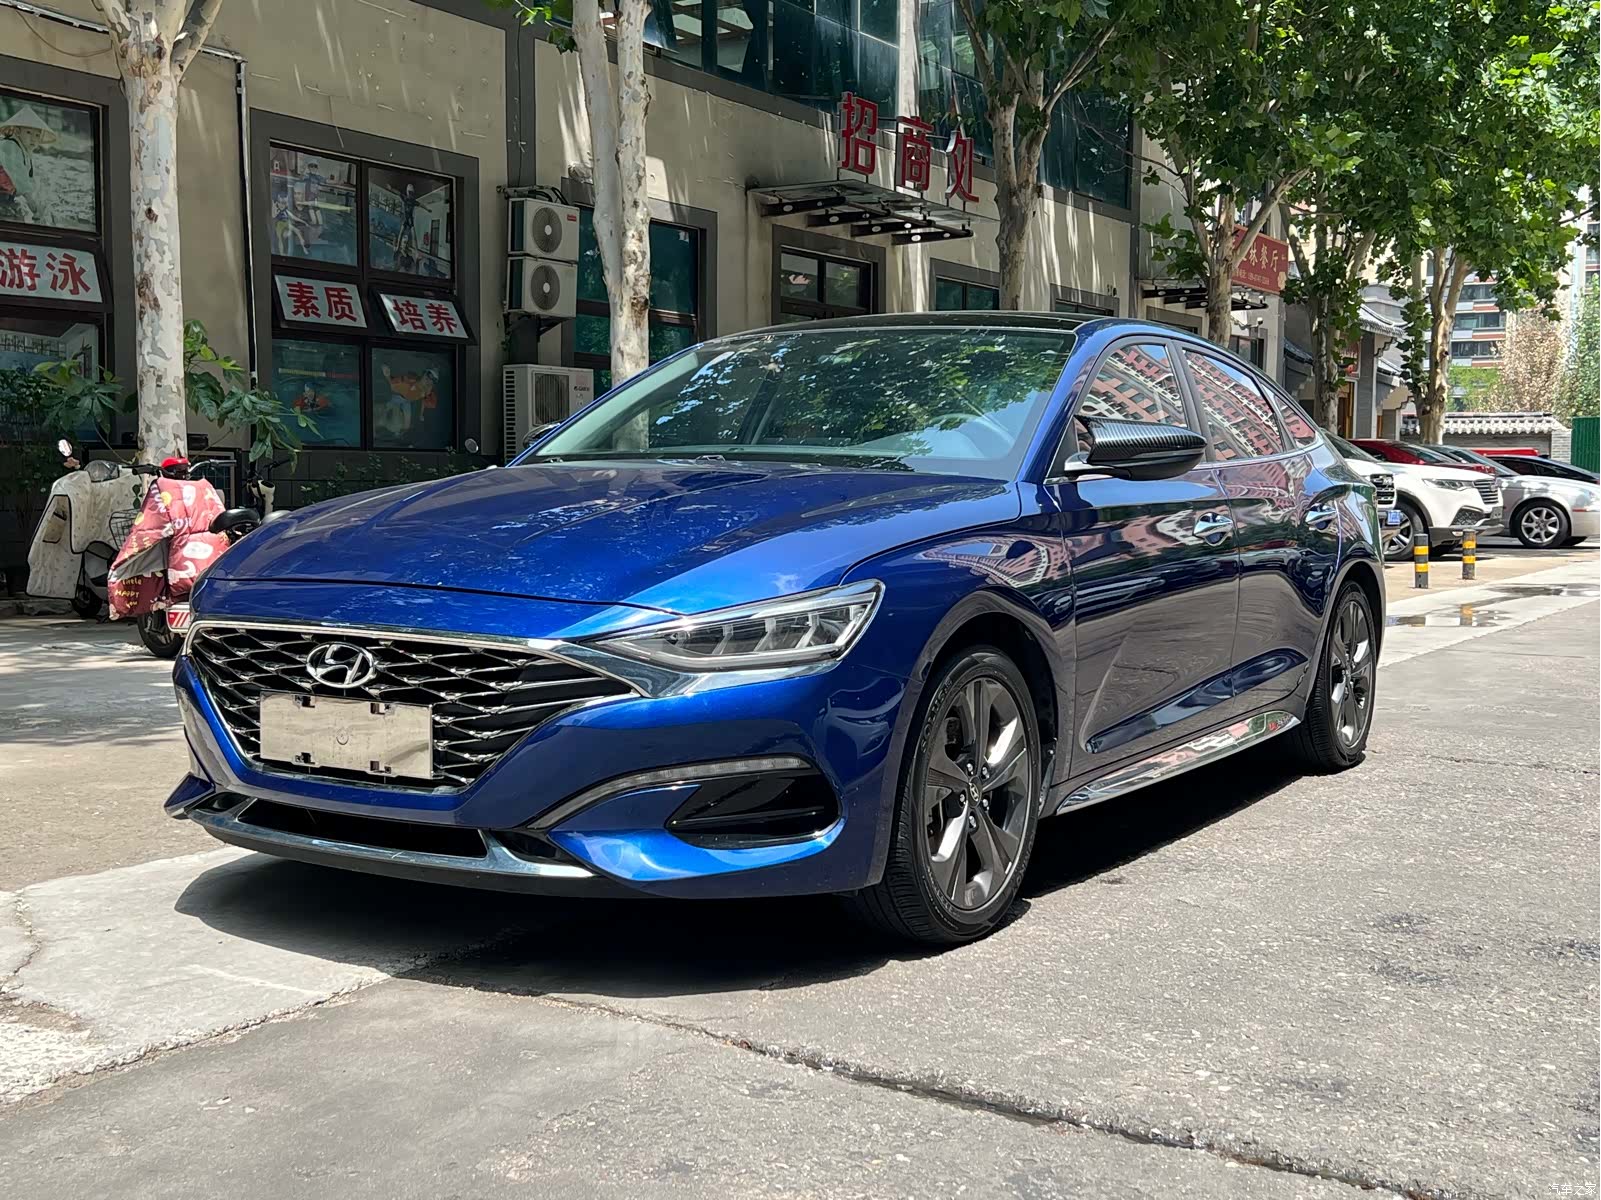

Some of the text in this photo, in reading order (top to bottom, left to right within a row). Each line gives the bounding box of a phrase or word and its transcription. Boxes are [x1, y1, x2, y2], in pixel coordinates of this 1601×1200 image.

[838, 91, 979, 203] 招商处
[0, 247, 92, 296] 游泳
[285, 281, 357, 323] 素质
[393, 299, 457, 335] 培养
